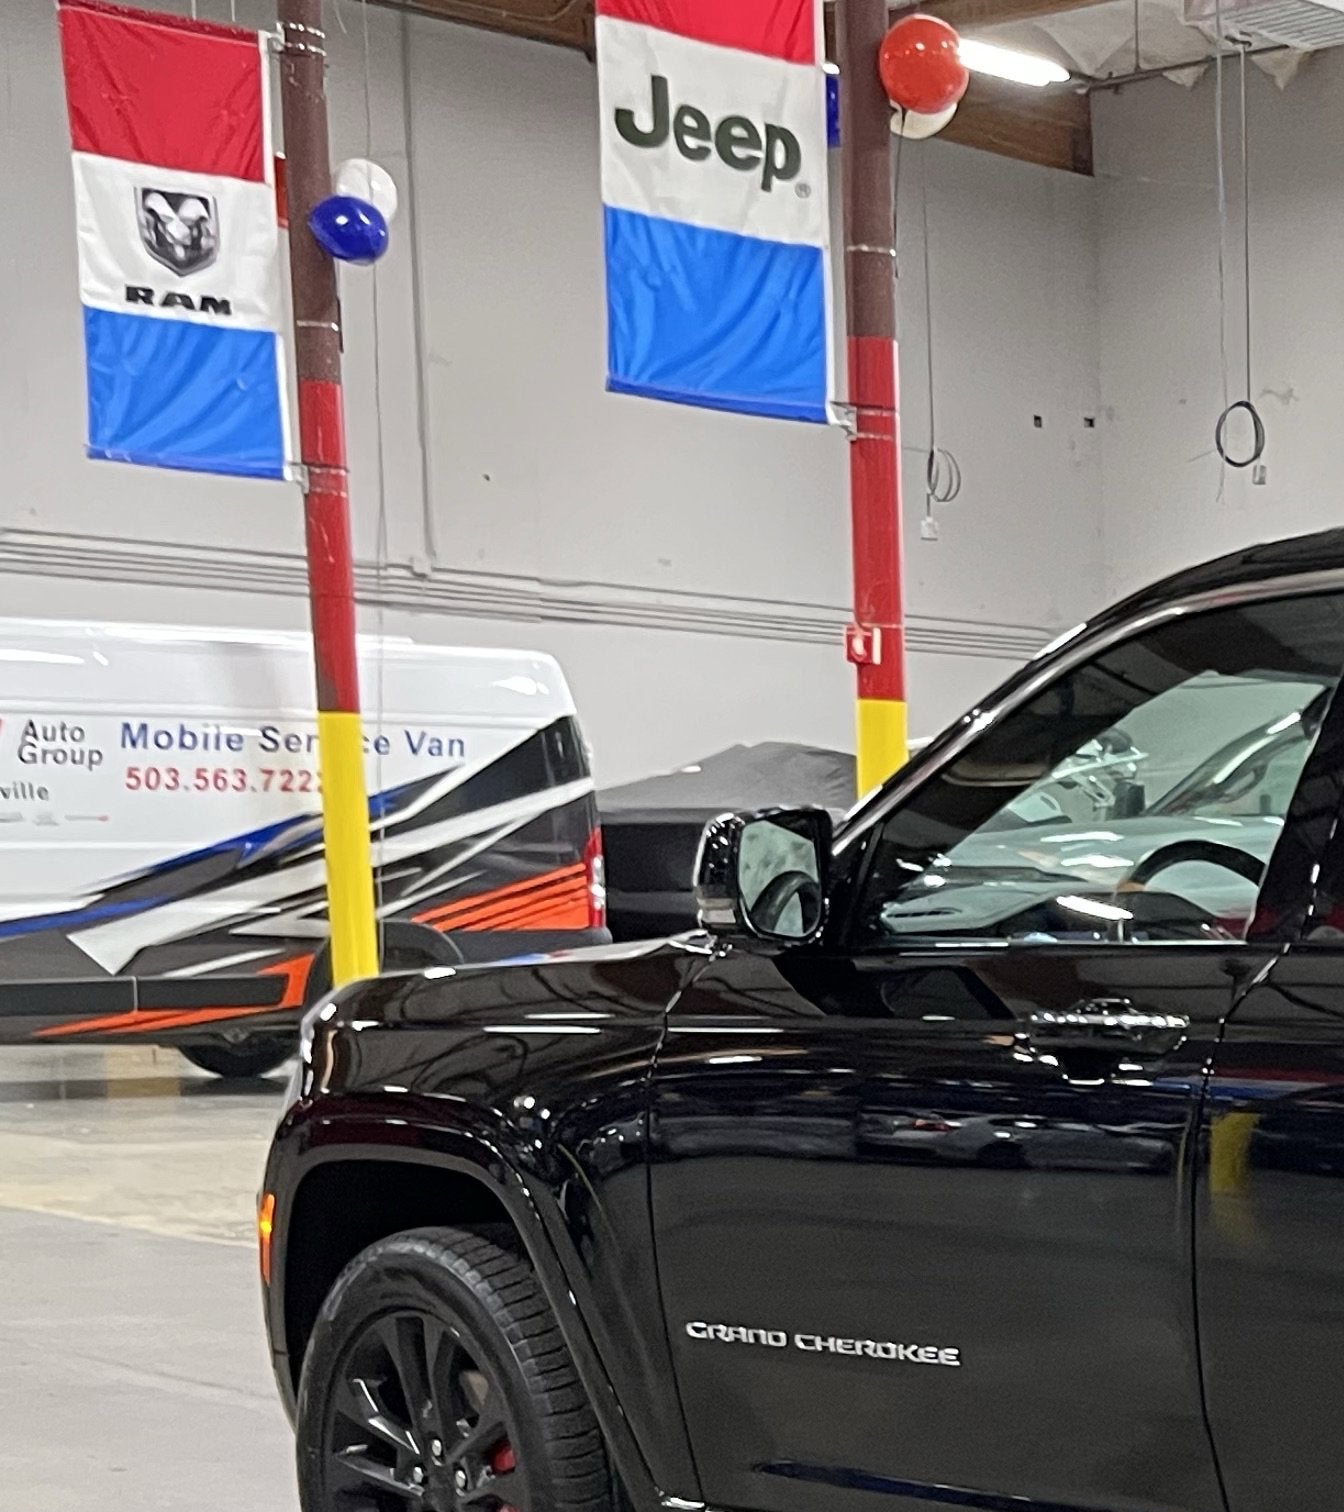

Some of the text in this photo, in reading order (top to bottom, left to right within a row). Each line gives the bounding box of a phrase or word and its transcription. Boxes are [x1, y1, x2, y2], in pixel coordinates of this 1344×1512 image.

[614, 75, 801, 192] Jeep
[125, 286, 232, 315] RAM
[22, 719, 85, 743] Auto
[120, 722, 465, 757] Mobile Sere Van
[18, 741, 103, 771] Group
[685, 1321, 960, 1366] GRAND CHEROKEE
